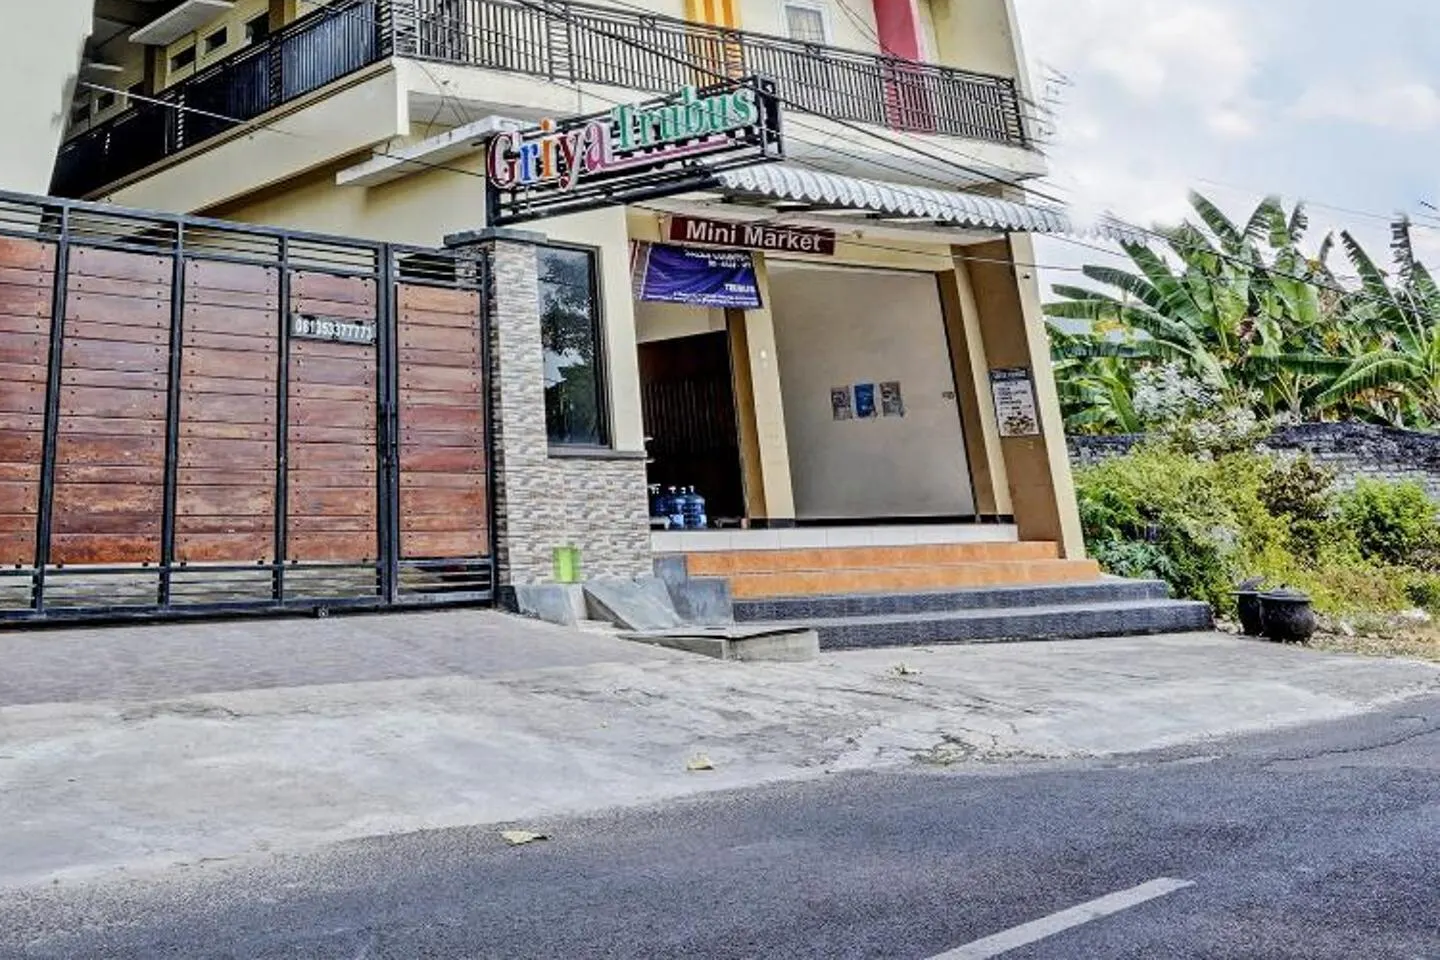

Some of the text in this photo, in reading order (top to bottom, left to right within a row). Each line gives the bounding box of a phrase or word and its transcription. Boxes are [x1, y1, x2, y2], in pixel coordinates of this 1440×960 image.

[488, 85, 756, 189] Griya Trubus
[686, 220, 821, 251] Mini Market
